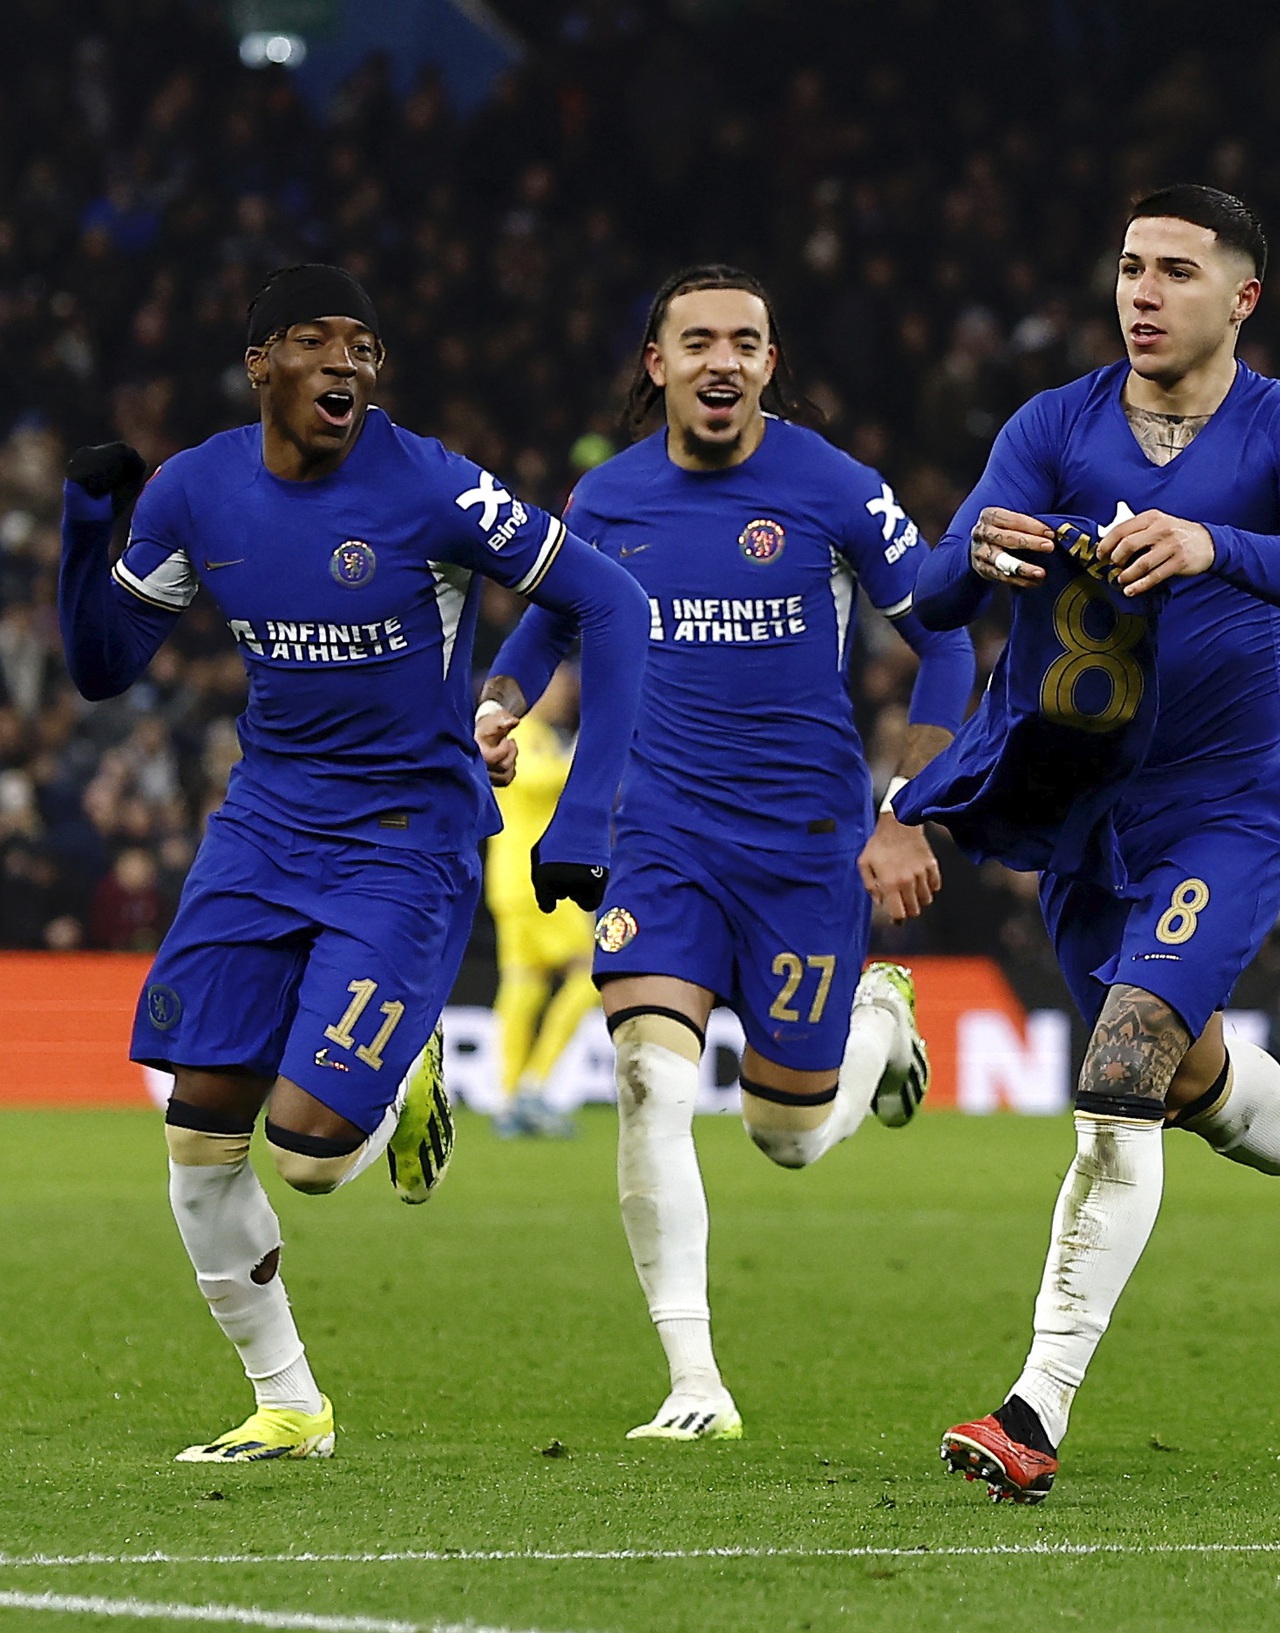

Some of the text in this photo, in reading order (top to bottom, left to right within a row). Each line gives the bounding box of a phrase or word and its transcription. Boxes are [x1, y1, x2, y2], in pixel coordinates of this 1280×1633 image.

[266, 616, 402, 644] INFINITE
[673, 595, 802, 621] INFINITE
[674, 617, 807, 642] ATHLETE
[271, 635, 408, 662] ATHLETE
[1040, 574, 1147, 733] 8
[1155, 878, 1210, 945] 8
[769, 952, 836, 1023] 27
[324, 978, 405, 1071] 11
